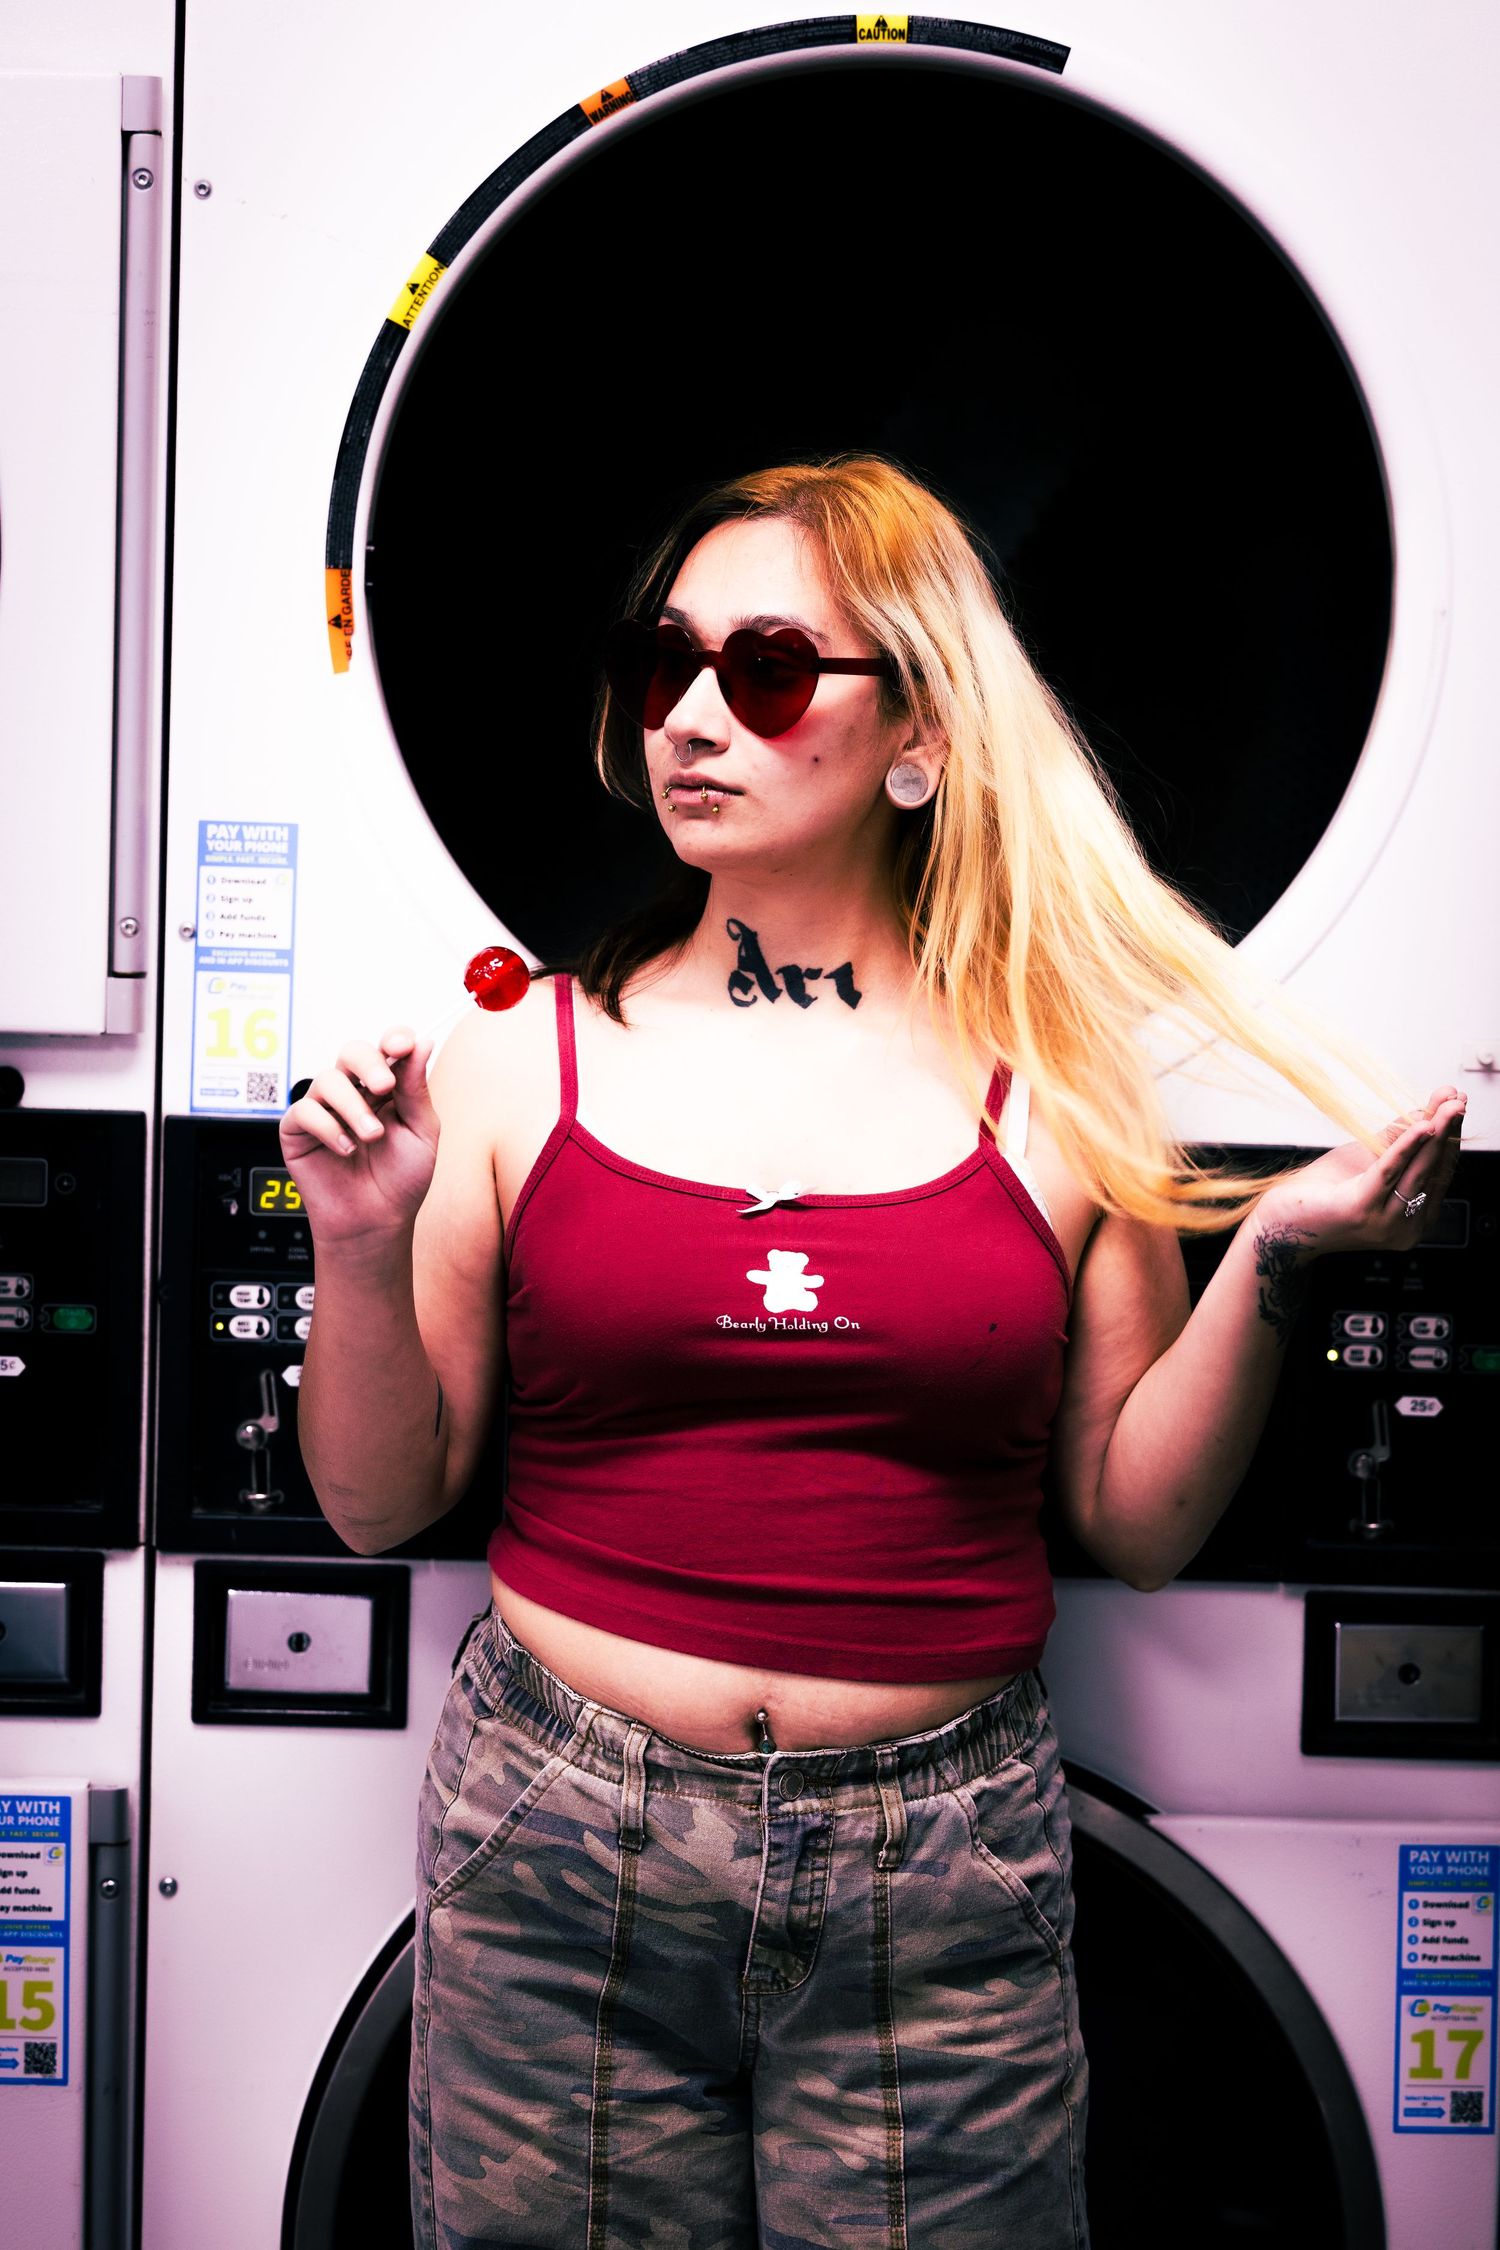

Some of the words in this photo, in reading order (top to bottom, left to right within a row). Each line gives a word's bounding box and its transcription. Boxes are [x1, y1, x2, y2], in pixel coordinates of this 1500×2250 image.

[858, 28, 905, 40] CAUTION
[1023, 38, 1068, 58] OUTDOORS
[588, 91, 634, 125] WARNING
[402, 262, 445, 328] ATTENTION
[340, 569, 352, 615] GARDE
[343, 619, 353, 636] EN
[207, 824, 240, 840] PAY
[242, 825, 288, 841] WITH
[207, 840, 242, 852] YOUR
[244, 841, 288, 853] PHONE
[221, 877, 266, 885] Download
[221, 895, 239, 904] Sign
[220, 931, 234, 939] Pay
[206, 1008, 278, 1060] 16
[259, 1178, 302, 1210] 25
[716, 1314, 766, 1333] Bearly
[768, 1316, 828, 1333] Holding
[834, 1316, 860, 1330] On
[0, 1359, 15, 1371] 5¢
[16, 1801, 60, 1814] WITH
[0, 1816, 14, 1825] UR
[18, 1816, 60, 1826] PHONE
[0, 1851, 41, 1859] ownload
[1409, 1850, 1440, 1863] PAY
[1445, 1850, 1489, 1863] WITH
[0, 1868, 14, 1879] ign
[16, 1871, 28, 1879] up
[1409, 1866, 1443, 1875] YOUR
[1447, 1866, 1489, 1875] PHONE
[0, 1886, 12, 1894] dd
[14, 1886, 41, 1895] funds
[0, 1905, 10, 1914] ay
[13, 1904, 53, 1913] machine
[1422, 1900, 1469, 1909] Download
[1422, 1918, 1442, 1928] Sign
[1444, 1920, 1456, 1928] up
[1422, 1936, 1440, 1944] Add
[1442, 1936, 1469, 1944] funds
[1421, 1953, 1438, 1963] Pay
[1440, 1953, 1481, 1962] machine
[1409, 2029, 1484, 2080] 17
